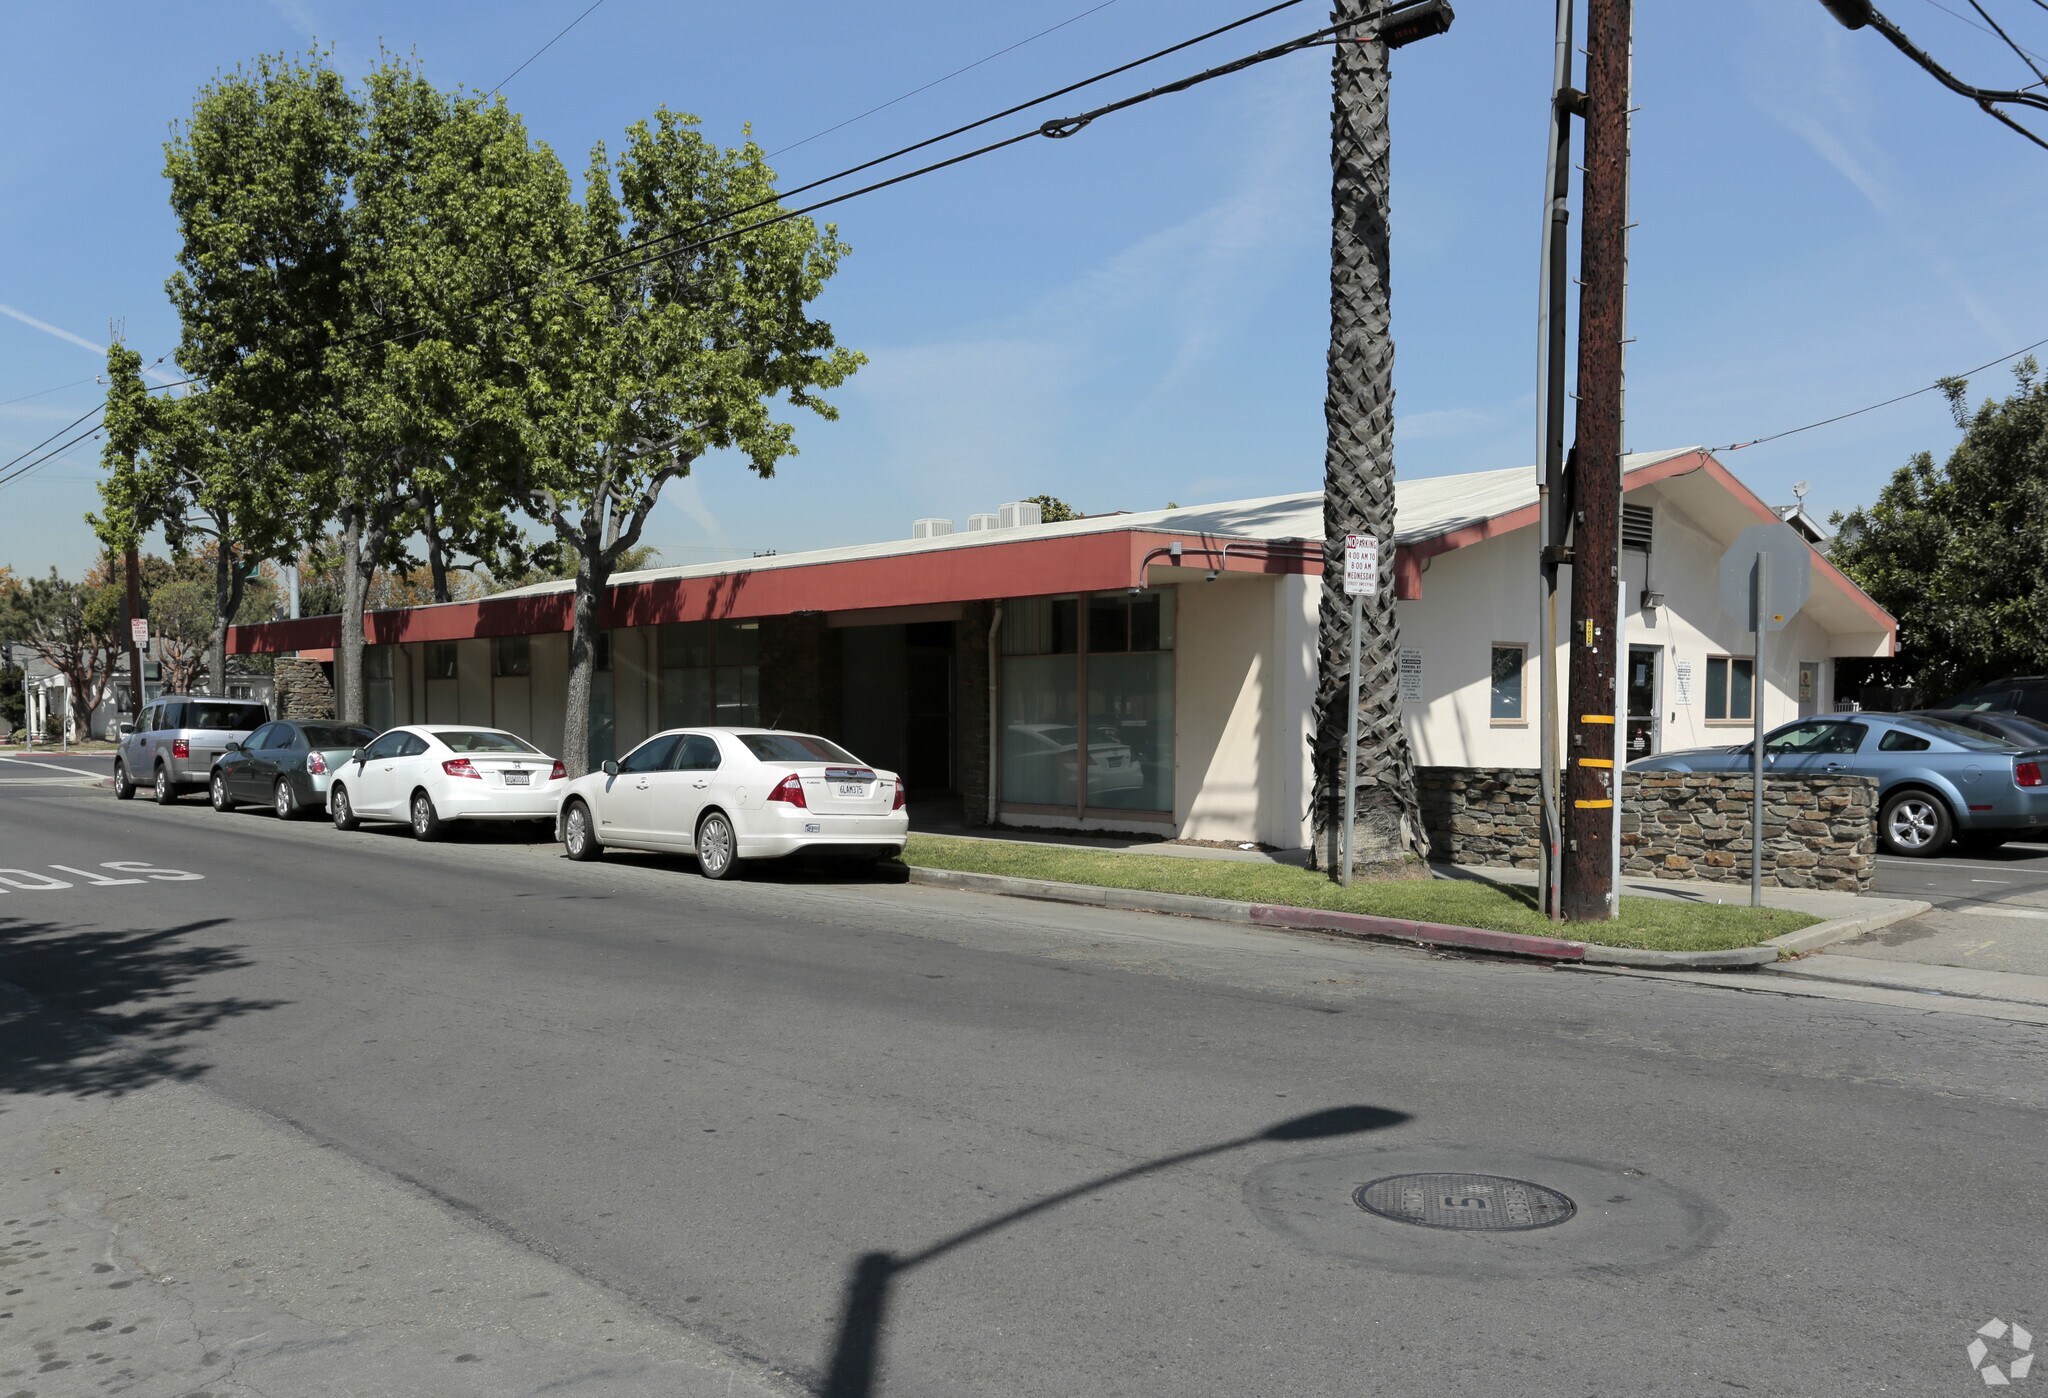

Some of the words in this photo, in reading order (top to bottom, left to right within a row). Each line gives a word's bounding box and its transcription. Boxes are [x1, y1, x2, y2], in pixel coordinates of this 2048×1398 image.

[1347, 536, 1356, 548] NO
[1357, 539, 1376, 549] PARKING
[1369, 553, 1376, 561] TO
[1347, 572, 1375, 580] WEDNESDAY
[840, 785, 863, 794] 6LAM375
[0, 861, 205, 894] STO
